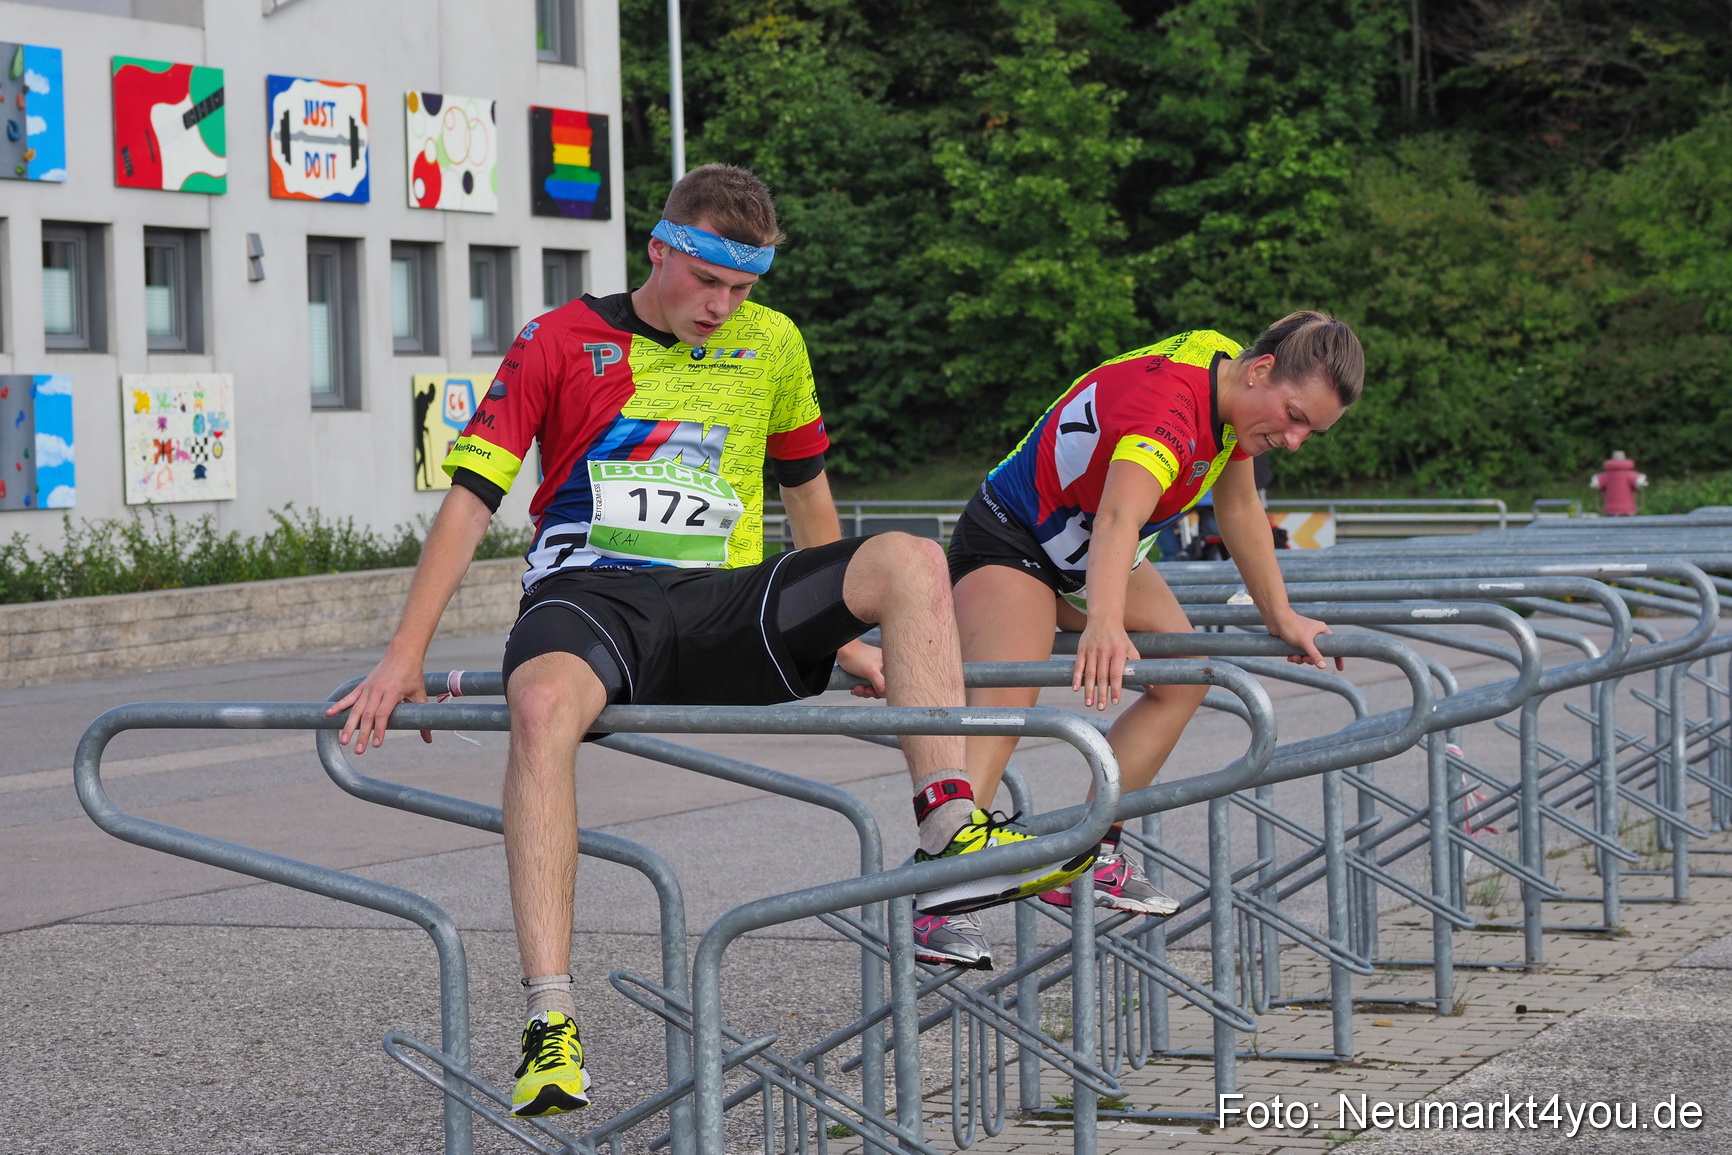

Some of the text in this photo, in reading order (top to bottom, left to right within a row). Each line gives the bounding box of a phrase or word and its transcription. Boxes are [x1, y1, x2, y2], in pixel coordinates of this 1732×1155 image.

[303, 99, 336, 128] JUST
[305, 151, 337, 180] DO IT
[1154, 425, 1185, 455] BMW
[601, 462, 726, 497] BOCK
[628, 487, 711, 528] 172
[608, 530, 640, 547] KAI
